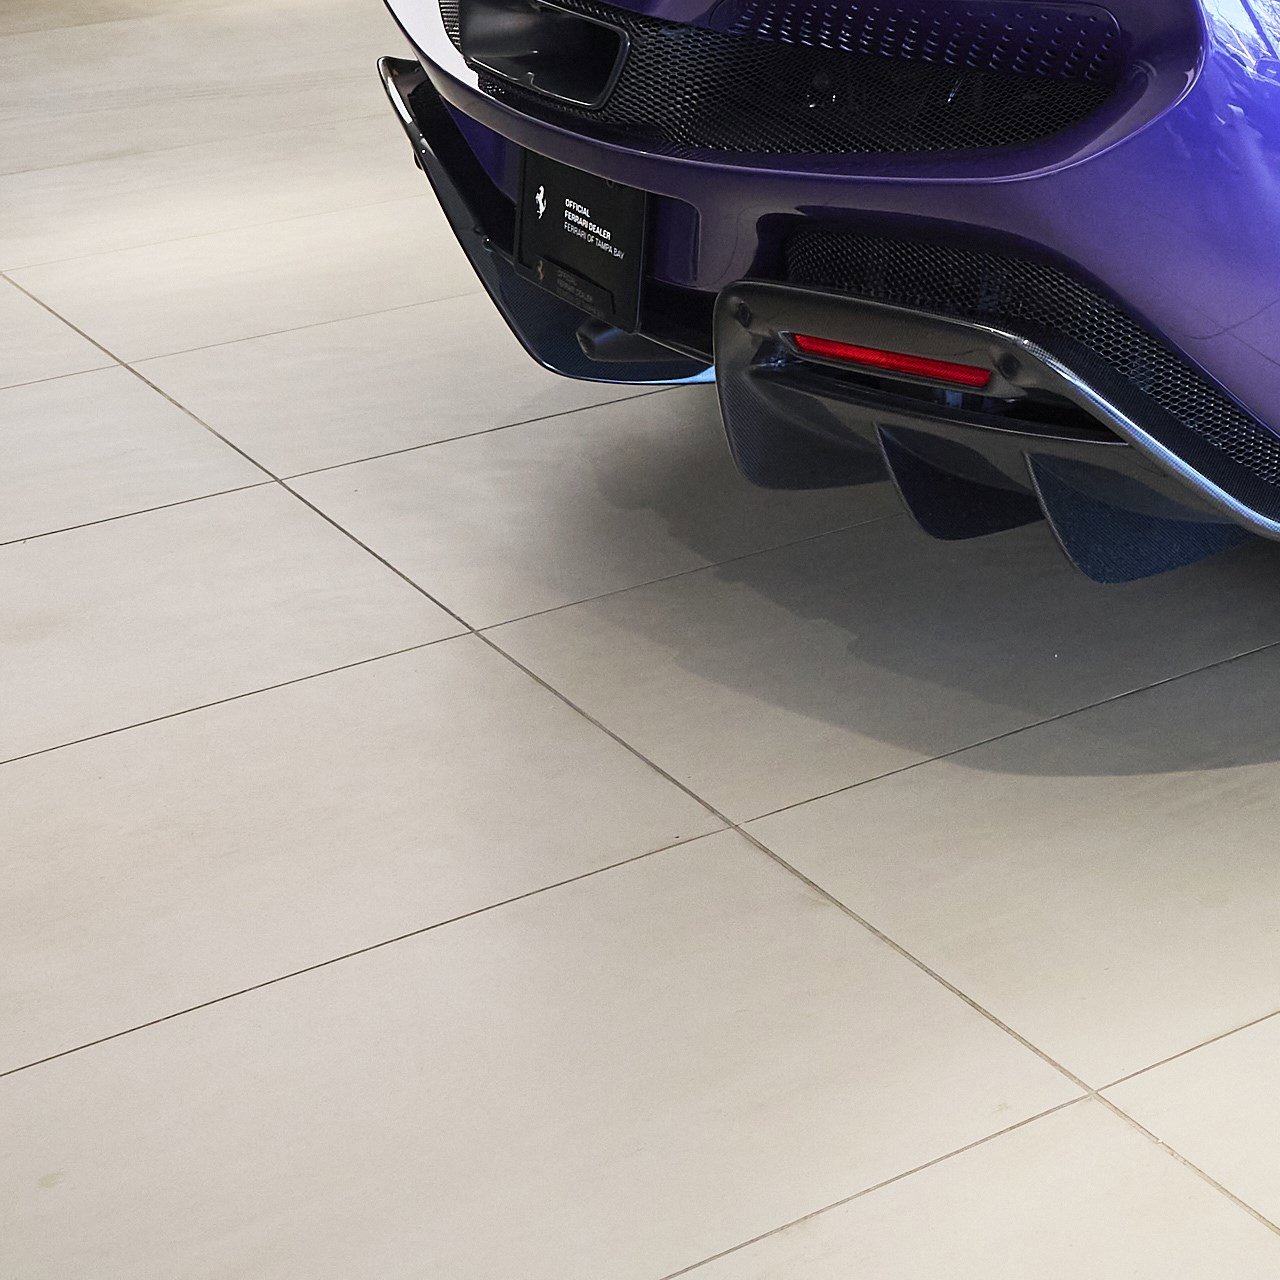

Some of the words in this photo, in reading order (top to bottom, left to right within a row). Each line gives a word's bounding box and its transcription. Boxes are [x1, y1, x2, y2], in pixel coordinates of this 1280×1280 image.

[564, 198, 591, 218] OFFICIAL
[564, 209, 588, 229] FERRARI
[588, 222, 611, 241] DEALER
[564, 221, 587, 240] FERRARI
[587, 233, 595, 243] OF
[595, 237, 613, 255] TAMPA
[613, 247, 625, 260] BAY
